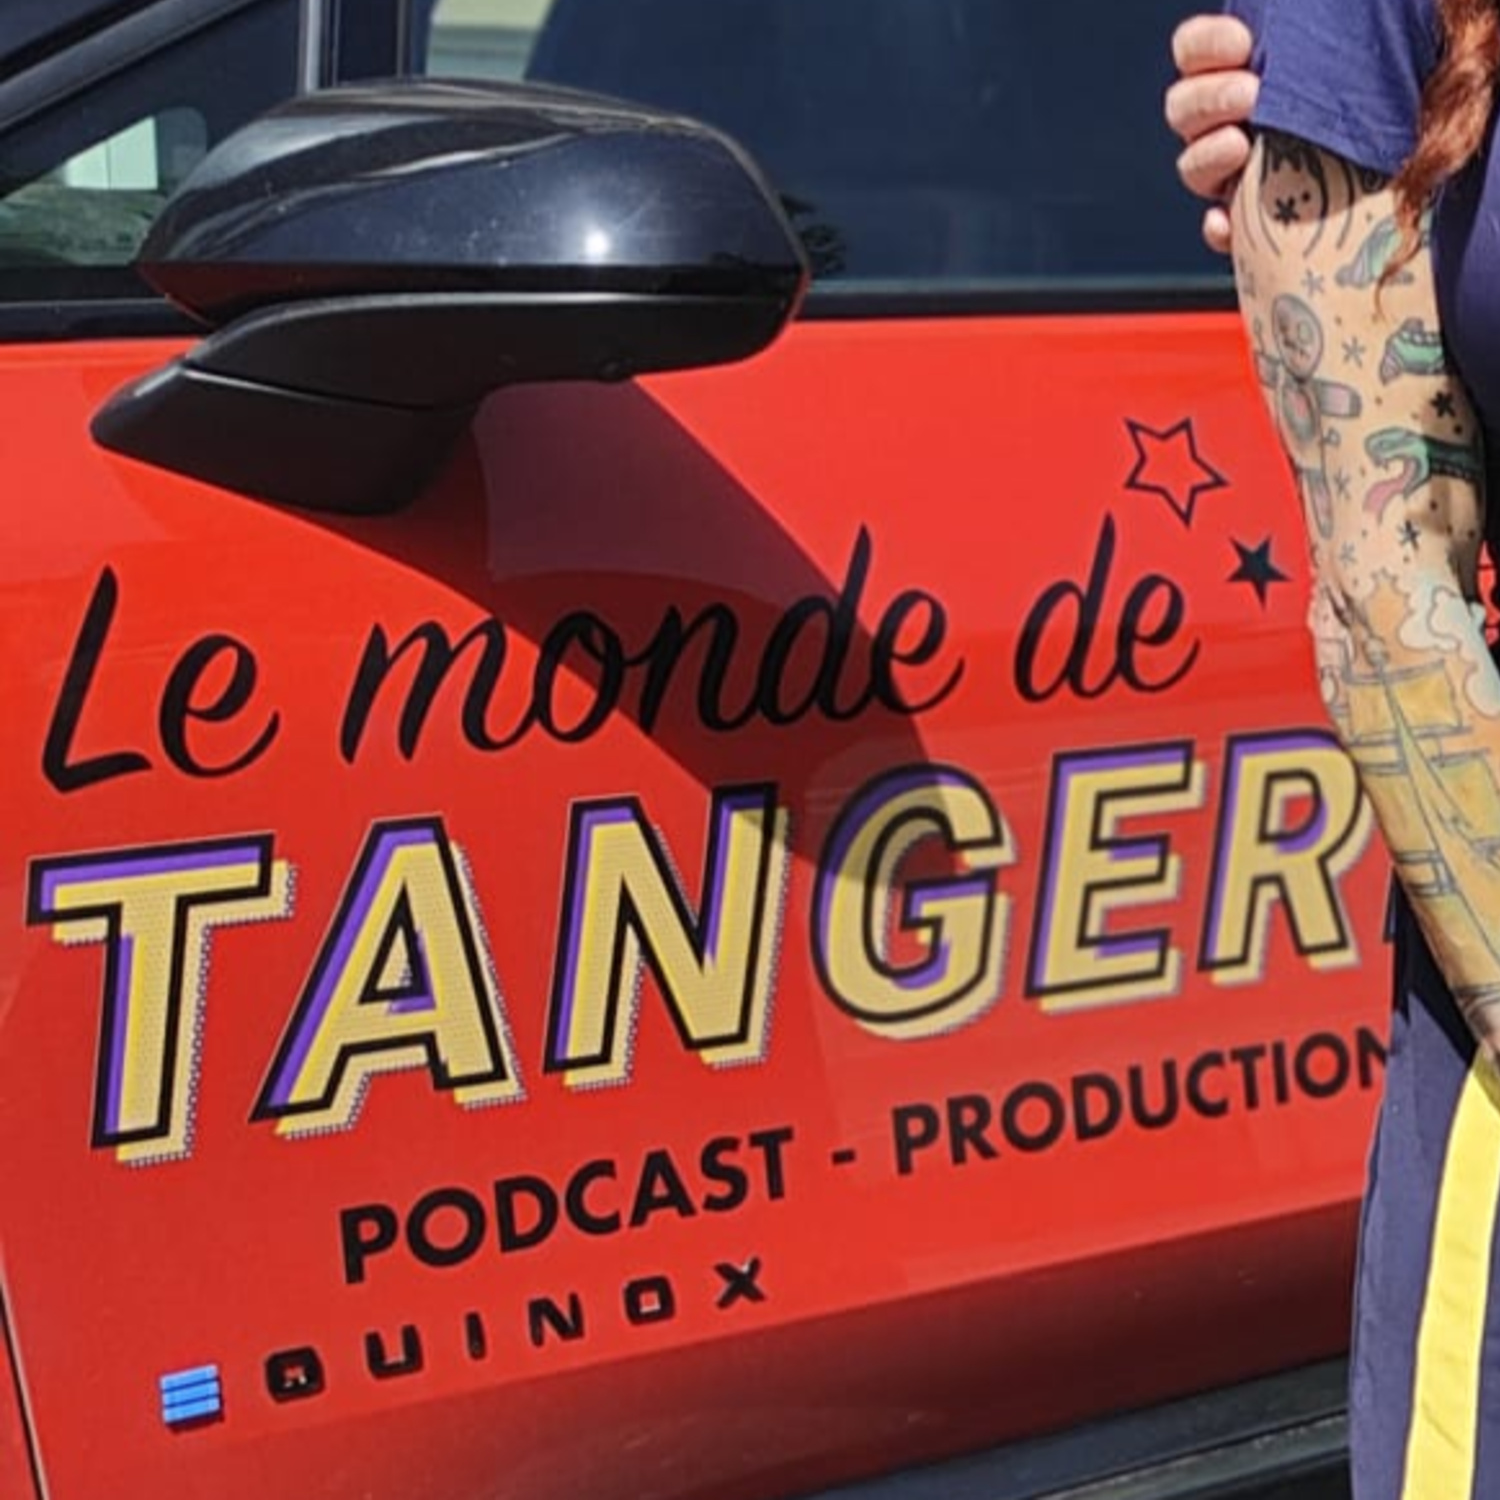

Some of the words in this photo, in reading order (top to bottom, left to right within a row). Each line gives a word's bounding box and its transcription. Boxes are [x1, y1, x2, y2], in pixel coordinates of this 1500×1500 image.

[42, 564, 281, 793] Le
[339, 522, 966, 765] monde
[1012, 511, 1202, 703] de
[26, 727, 1394, 1168] TANGER
[339, 1126, 794, 1285] PODCAST
